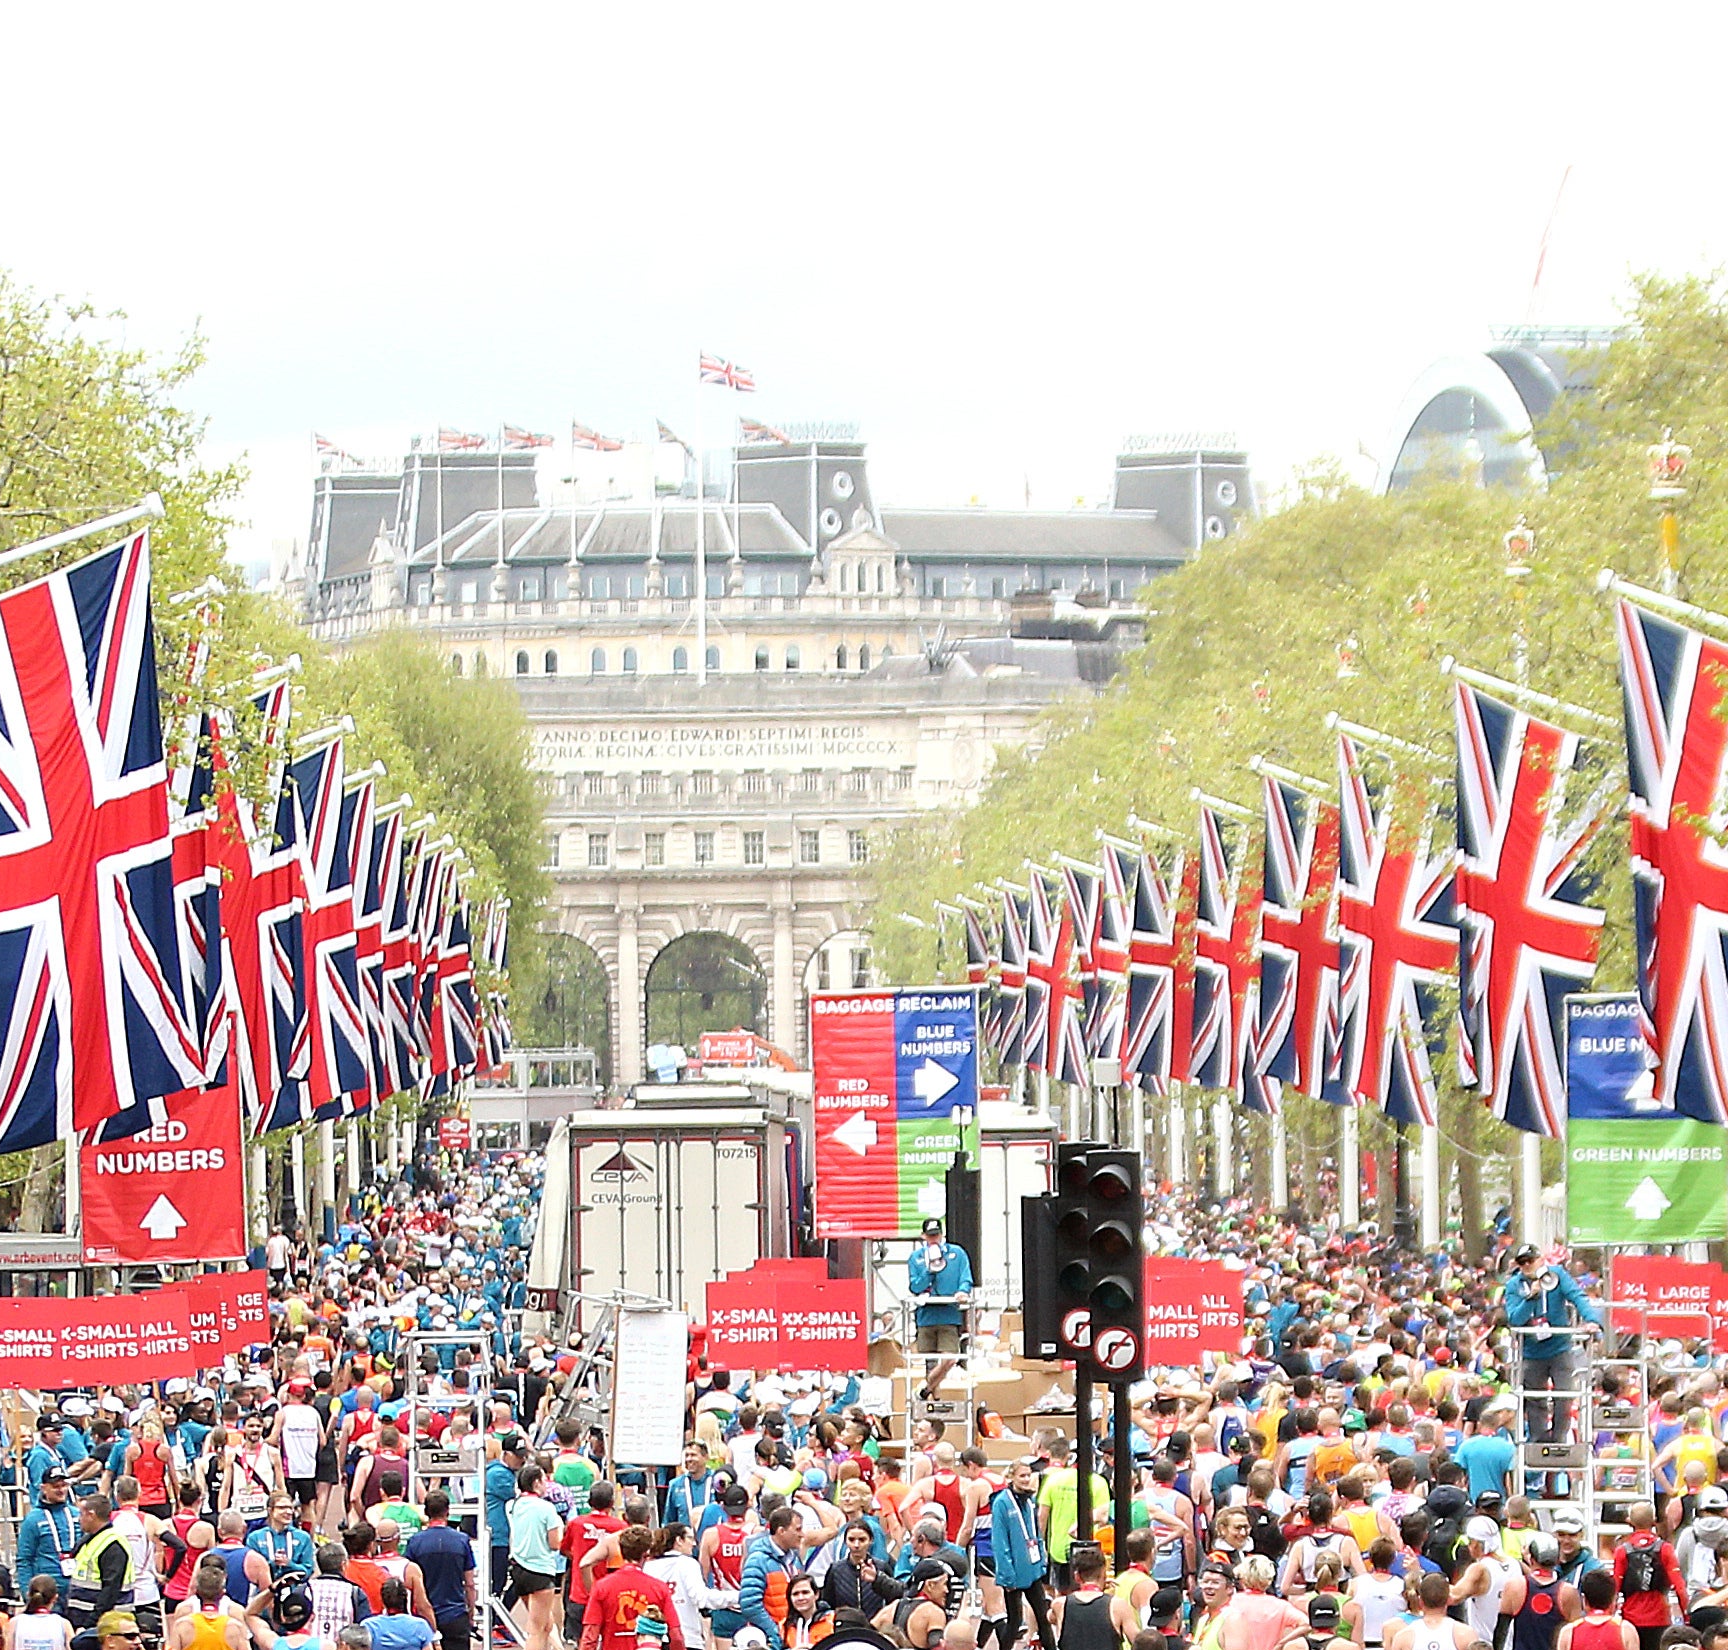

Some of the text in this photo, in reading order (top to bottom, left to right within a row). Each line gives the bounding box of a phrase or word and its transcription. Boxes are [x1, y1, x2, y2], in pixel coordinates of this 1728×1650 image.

[543, 730, 592, 743] ANNO
[599, 728, 663, 742] DECIMO
[749, 727, 813, 741] SEPTIMI
[821, 725, 865, 739] REGIS
[815, 996, 972, 1016] BAGGAGE RECLAIM
[1572, 1004, 1641, 1020] BAGGAG
[916, 1025, 955, 1039] BLUE
[900, 1041, 972, 1056] NUMBERS
[1579, 1037, 1627, 1054] BLUE
[838, 1078, 869, 1093] RED
[818, 1094, 890, 1109] NUMBERS
[134, 1120, 186, 1143] RED
[915, 1134, 962, 1149] GREEN
[96, 1148, 226, 1175] NUMBERS
[903, 1150, 976, 1166] NUMBES
[1573, 1146, 1723, 1163] GREEN NUMBERS
[591, 1192, 664, 1205] CEVA Ground
[1658, 1286, 1711, 1300] LARGE
[781, 1311, 862, 1327] XX-SMALL
[1150, 1304, 1199, 1320] MALL
[786, 1325, 858, 1341] T-SHIRTS
[1148, 1323, 1200, 1339] HIRTS
[322, 1621, 332, 1636] 9
